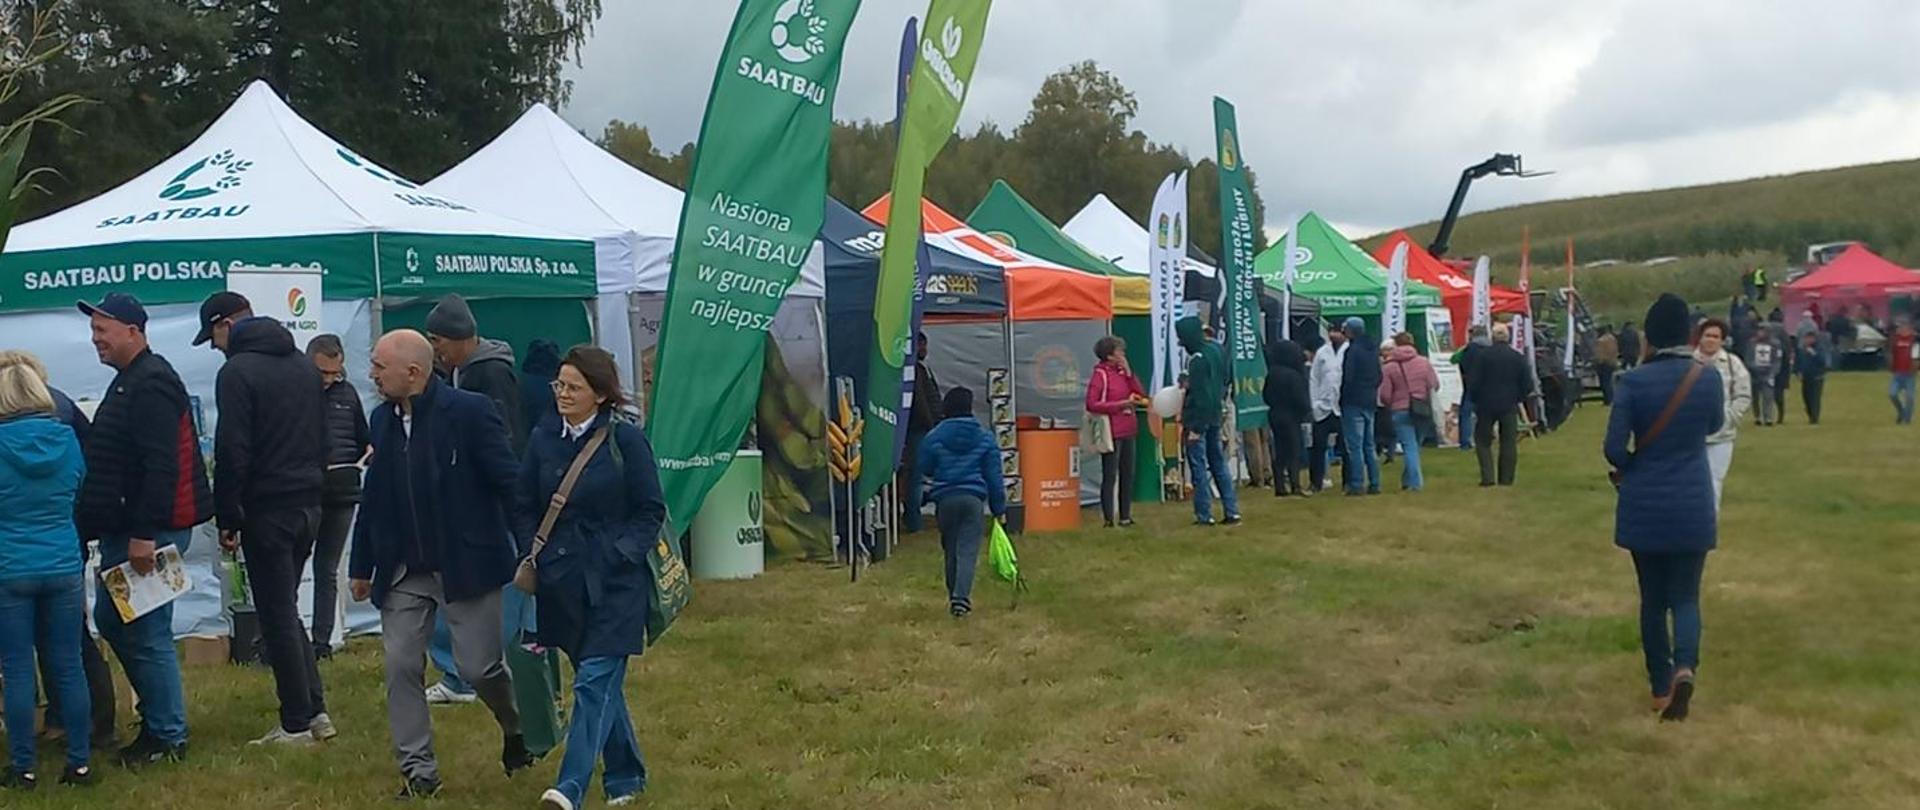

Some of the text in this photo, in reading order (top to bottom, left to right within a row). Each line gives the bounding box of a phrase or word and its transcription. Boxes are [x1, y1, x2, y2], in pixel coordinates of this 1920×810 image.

[737, 56, 826, 106] SAATBAU
[96, 205, 250, 228] SAATBAU
[710, 192, 791, 233] Nasiona
[702, 225, 807, 267] SAATBAU
[24, 265, 126, 290] SAATBAU
[133, 261, 224, 281] POLSKA
[435, 255, 489, 273] SAATBAU
[490, 256, 534, 274] POLSKA
[697, 264, 717, 282] w
